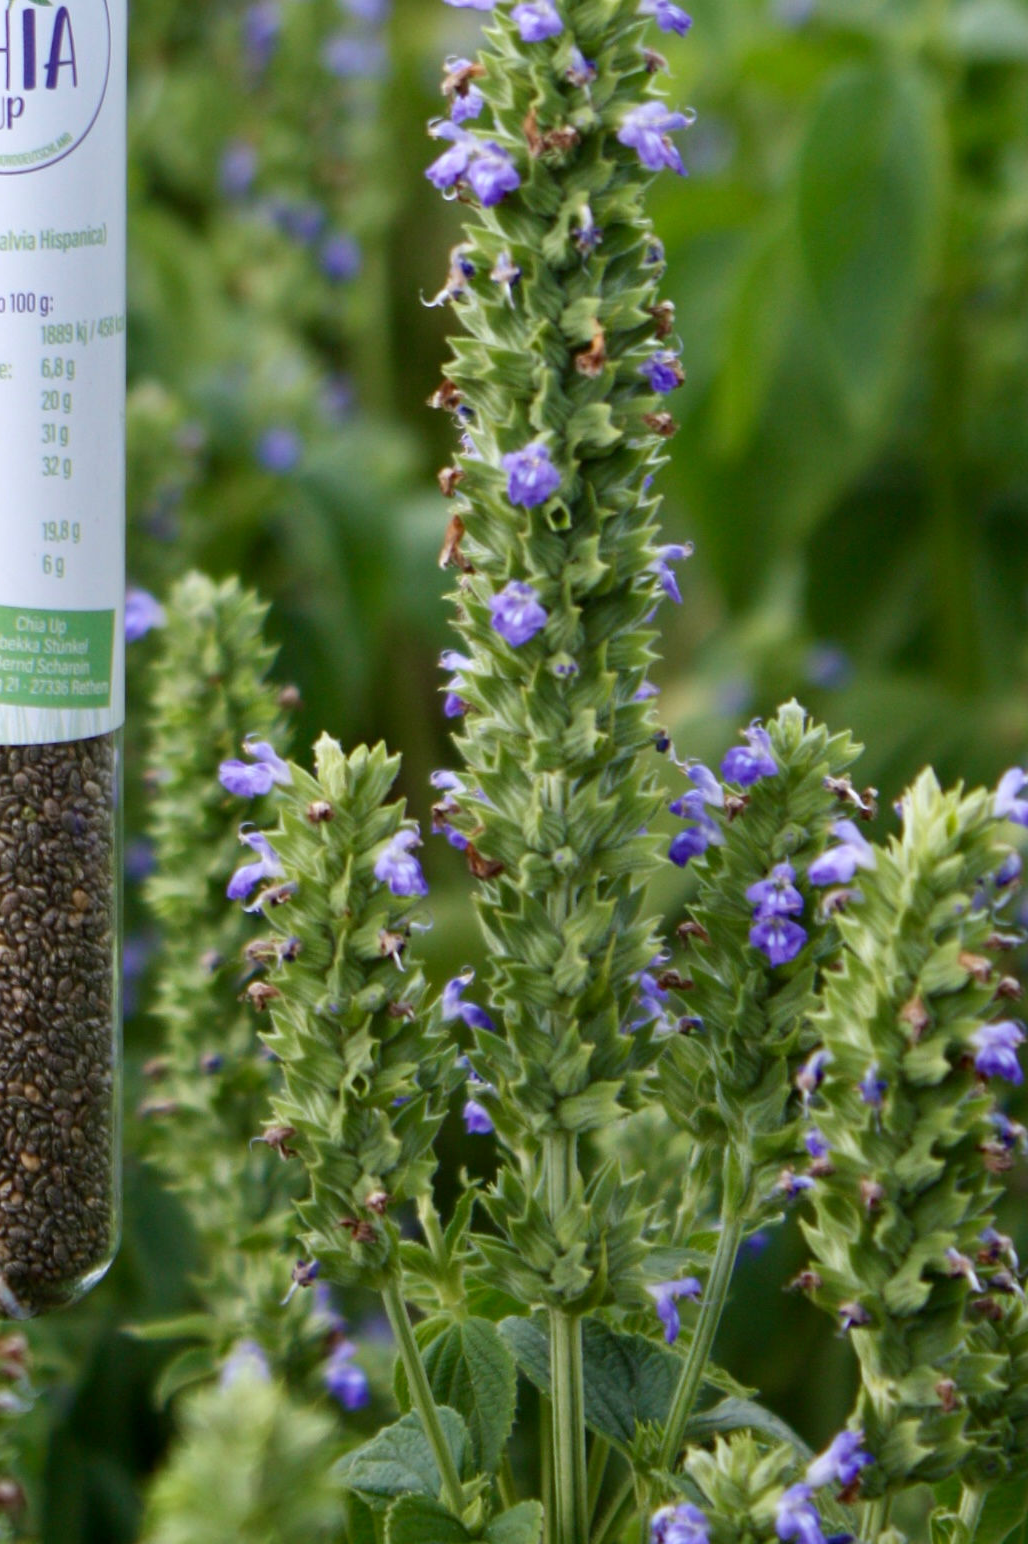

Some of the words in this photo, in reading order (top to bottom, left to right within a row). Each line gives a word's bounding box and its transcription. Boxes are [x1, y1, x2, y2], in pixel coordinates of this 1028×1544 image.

[40, 222, 108, 253] Hispanica)
[10, 292, 36, 314] 100
[39, 296, 54, 317] g:
[41, 323, 73, 345] 1889
[41, 357, 64, 379] 6,8
[66, 360, 76, 381] g
[41, 389, 60, 411] 20
[62, 393, 72, 414] g
[41, 423, 56, 445] 31
[59, 426, 69, 447] g
[42, 456, 60, 477] 32
[63, 458, 73, 480] g
[72, 522, 81, 544] g
[43, 553, 52, 575] 6
[55, 556, 65, 578] g
[15, 615, 46, 634] Chia
[49, 617, 67, 636] Up
